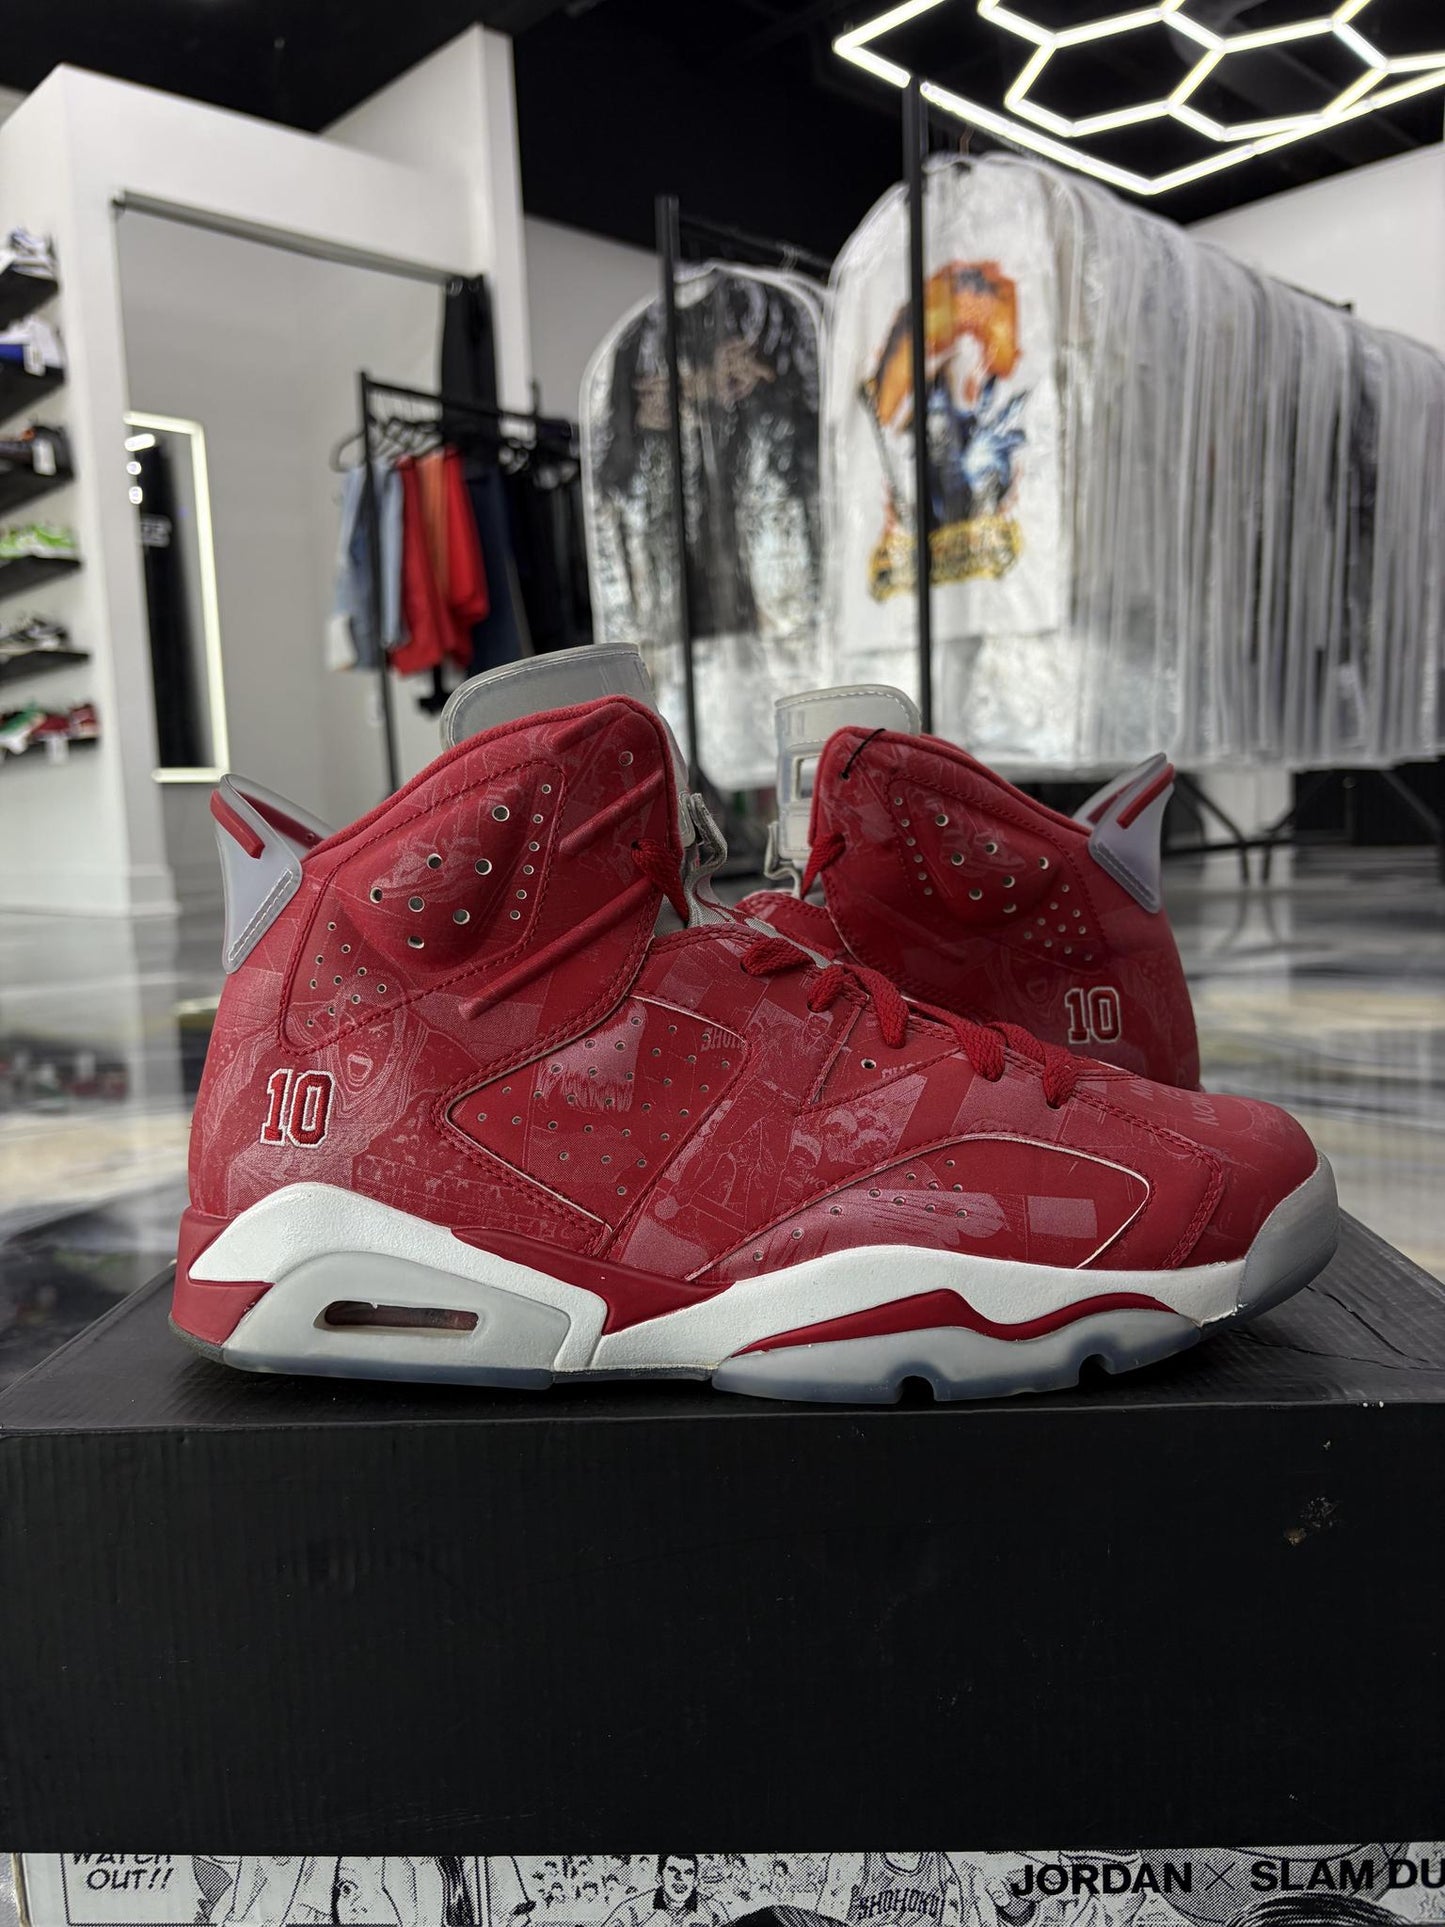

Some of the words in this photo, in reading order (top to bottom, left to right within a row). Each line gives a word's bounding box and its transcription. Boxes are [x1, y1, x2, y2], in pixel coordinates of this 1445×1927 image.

[1064, 986, 1121, 1044] 10
[260, 1067, 334, 1149] 10
[86, 1868, 174, 1891] OUT!!
[1010, 1862, 1192, 1896] JORDAN
[1250, 1859, 1374, 1892] SLAM
